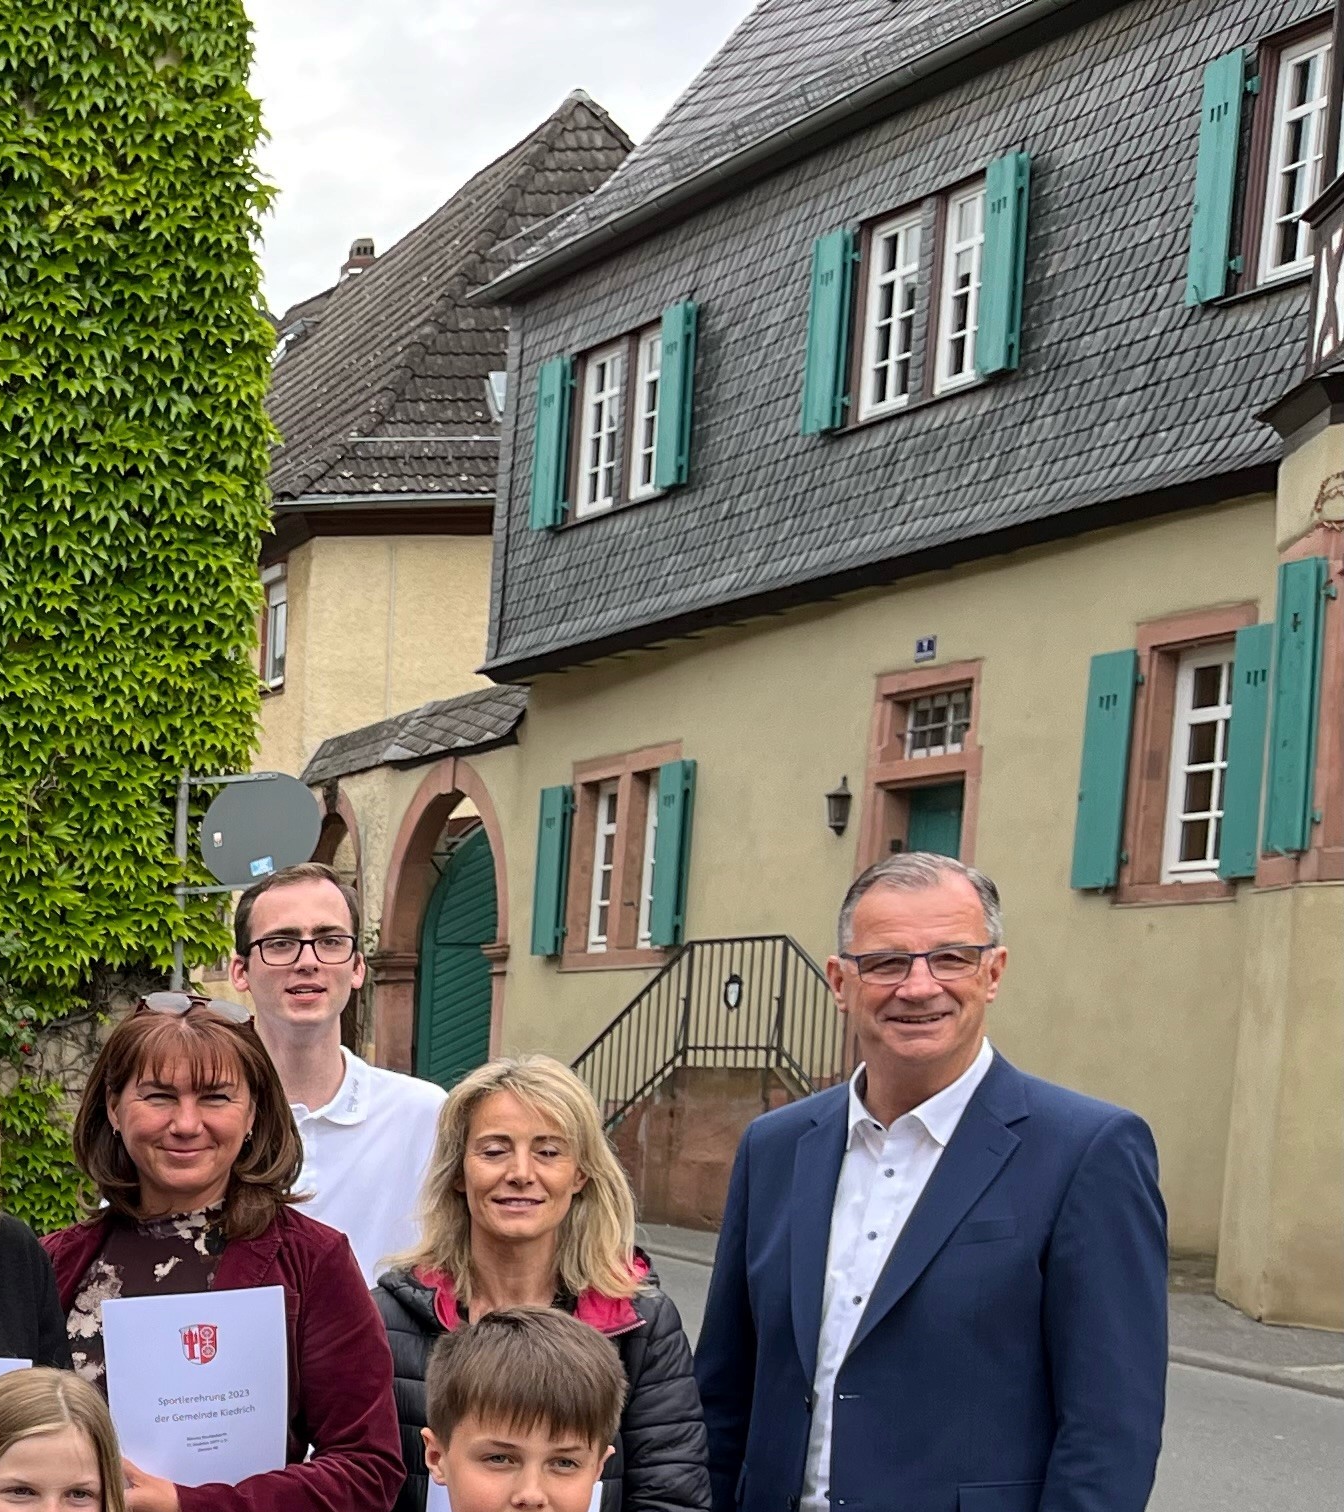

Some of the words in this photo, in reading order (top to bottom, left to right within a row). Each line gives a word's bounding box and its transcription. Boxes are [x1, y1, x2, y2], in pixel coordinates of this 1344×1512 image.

[157, 1393, 226, 1406] Sportlerehrung
[228, 1388, 250, 1400] 2023
[154, 1414, 170, 1423] der
[172, 1410, 218, 1422] Gemeinde
[220, 1404, 256, 1417] Kiedrich
